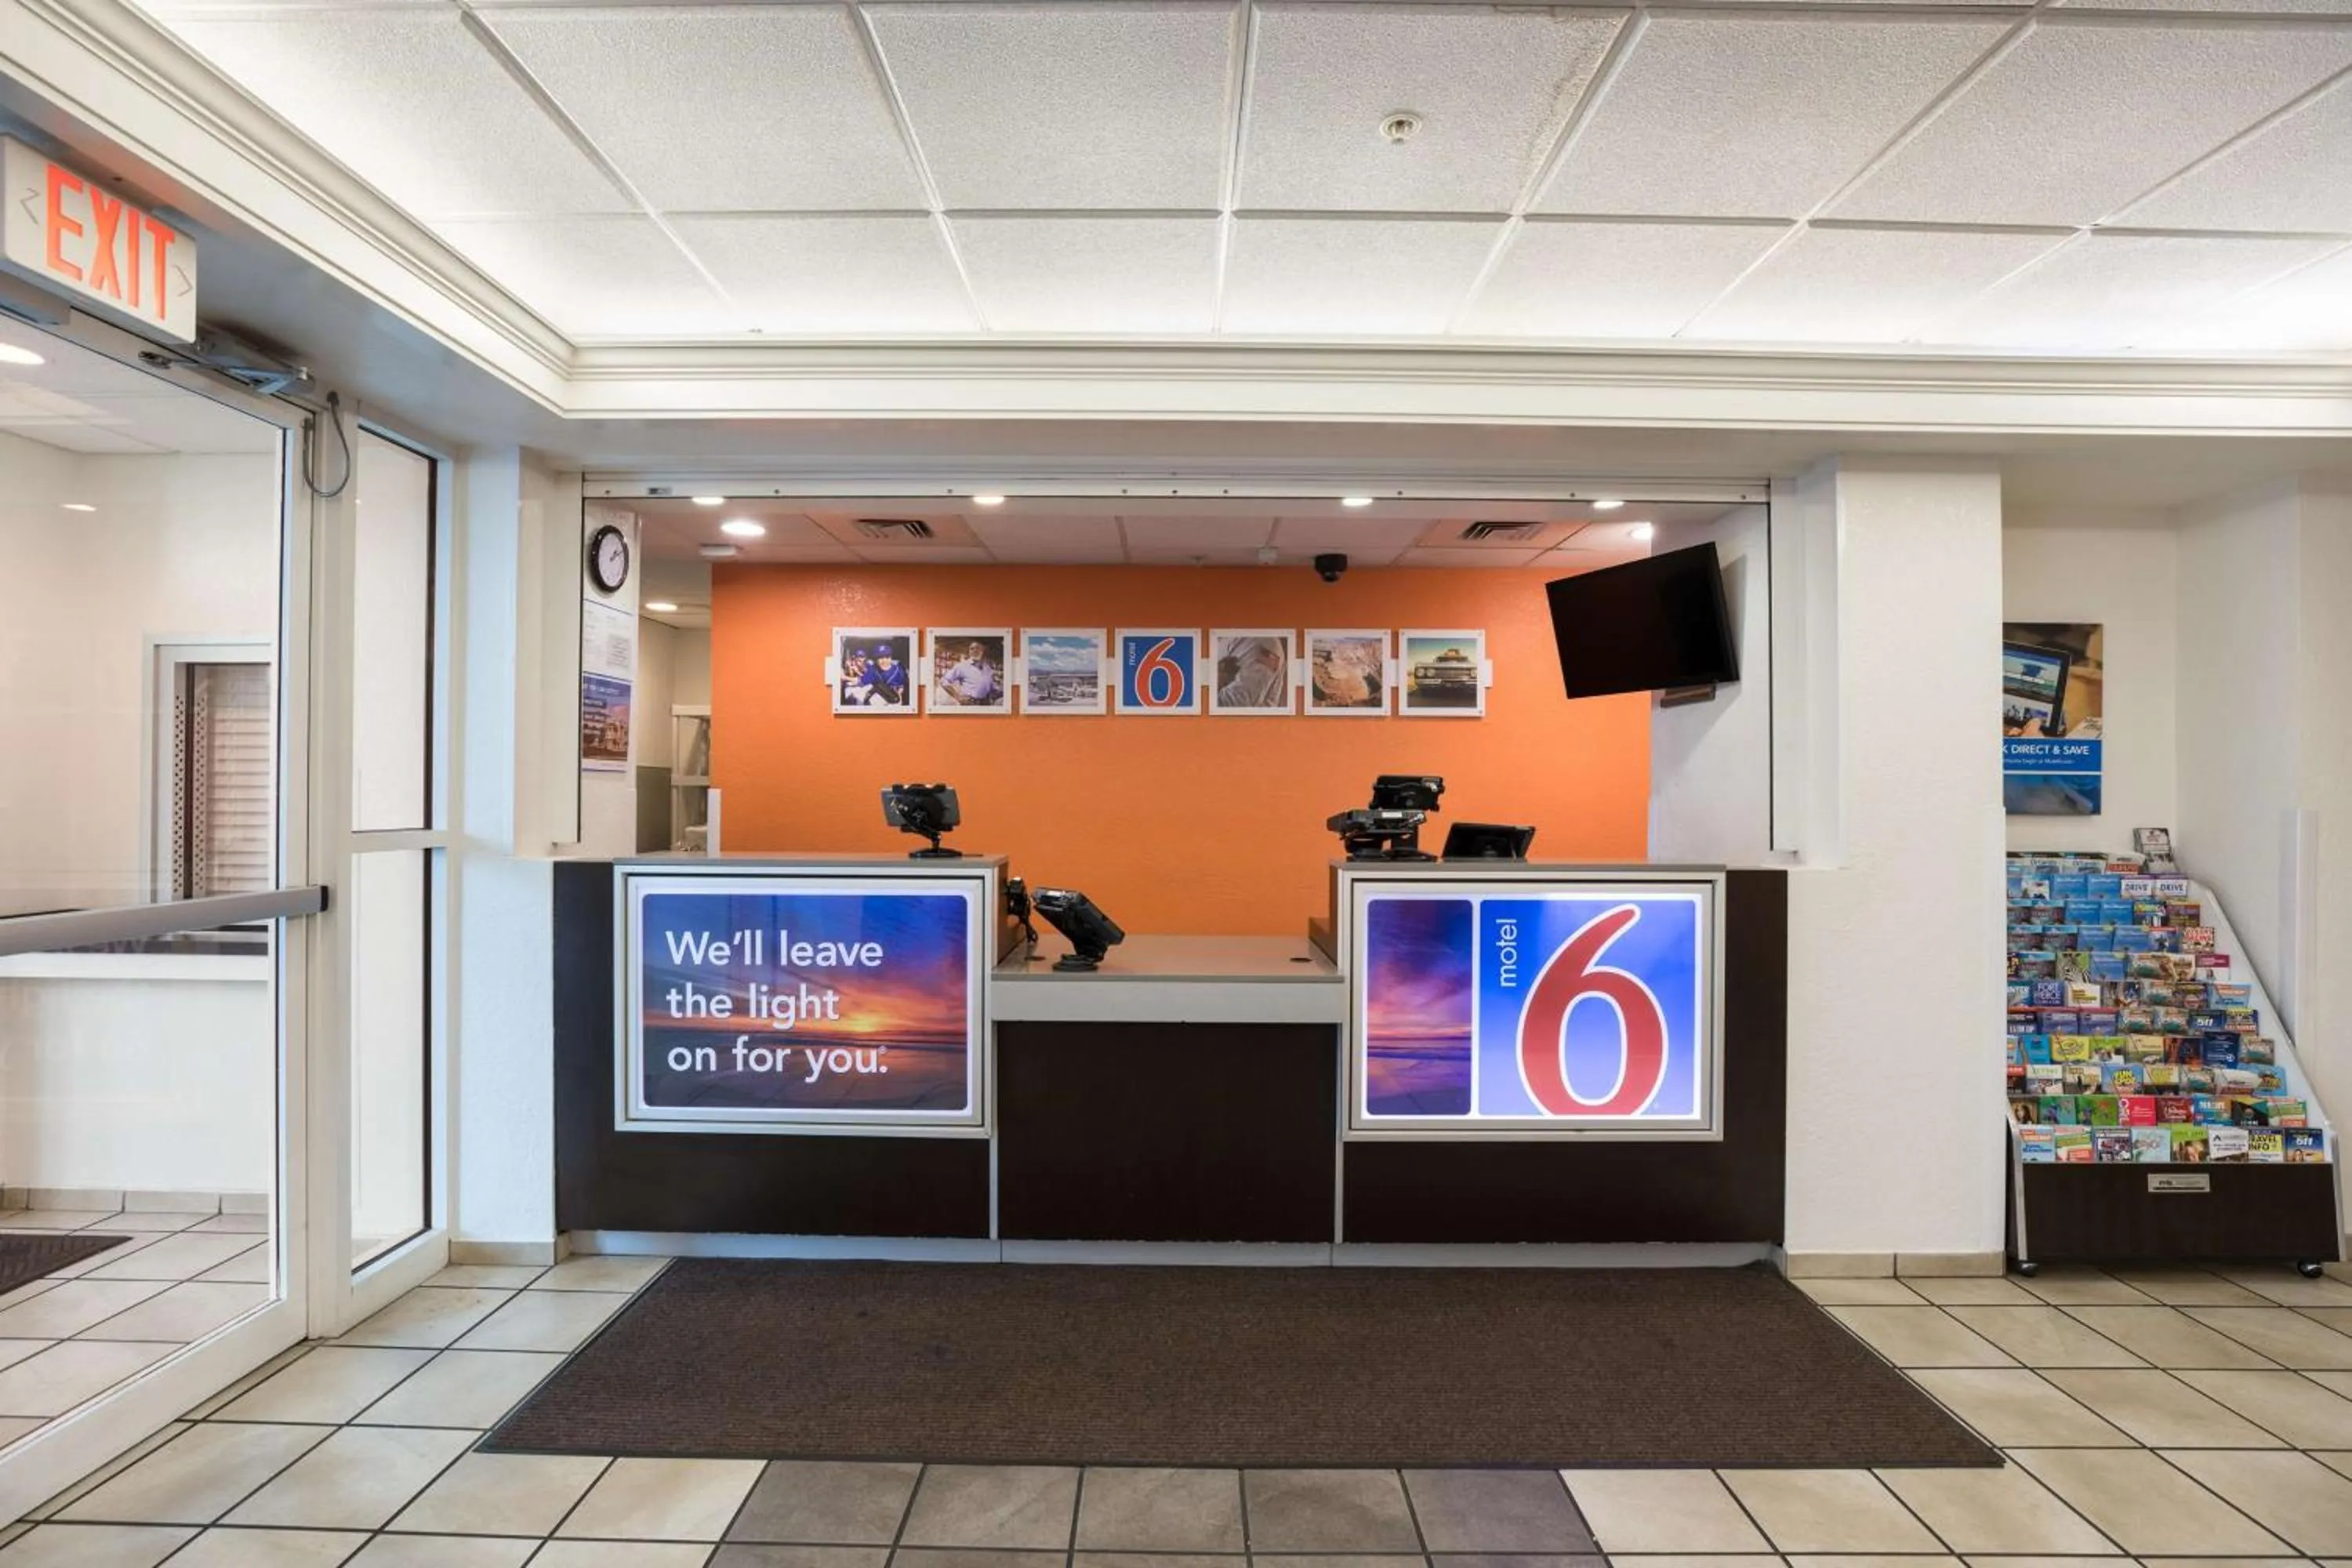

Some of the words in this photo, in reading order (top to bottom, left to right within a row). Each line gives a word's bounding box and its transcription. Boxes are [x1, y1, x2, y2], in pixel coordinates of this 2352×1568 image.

[45, 164, 176, 321] EXIT
[1135, 637, 1185, 709] 6
[2011, 744, 2049, 754] DIRECT
[2053, 745, 2060, 755] &
[2063, 746, 2089, 755] SAVE
[665, 929, 763, 966] We'll
[780, 929, 884, 967] leave
[1495, 918, 1516, 987] motel
[666, 982, 733, 1019] the
[749, 982, 840, 1029] light
[1515, 903, 1669, 1116] 6
[667, 1045, 717, 1073] on
[732, 1035, 791, 1073] for
